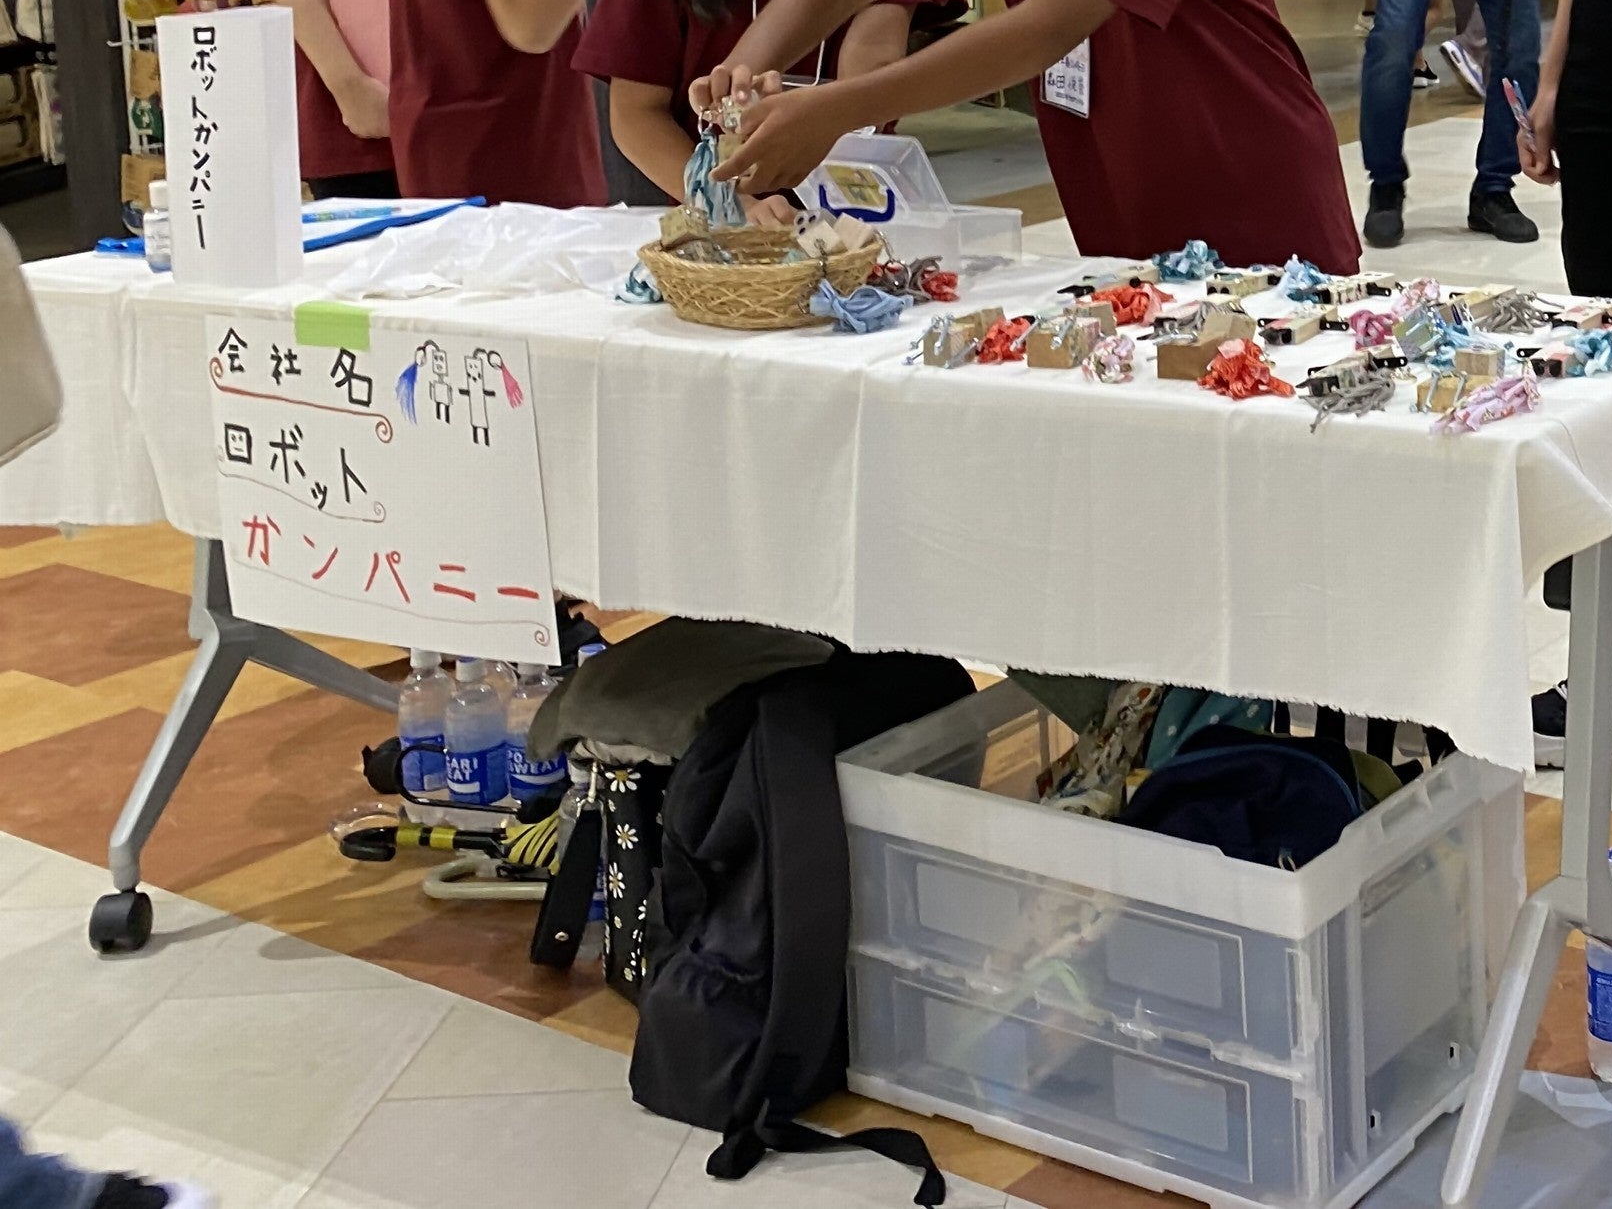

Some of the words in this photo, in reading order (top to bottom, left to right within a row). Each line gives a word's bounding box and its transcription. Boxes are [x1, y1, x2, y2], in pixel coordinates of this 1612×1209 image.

[218, 327, 373, 407] 会社名
[224, 422, 367, 511] ロボット
